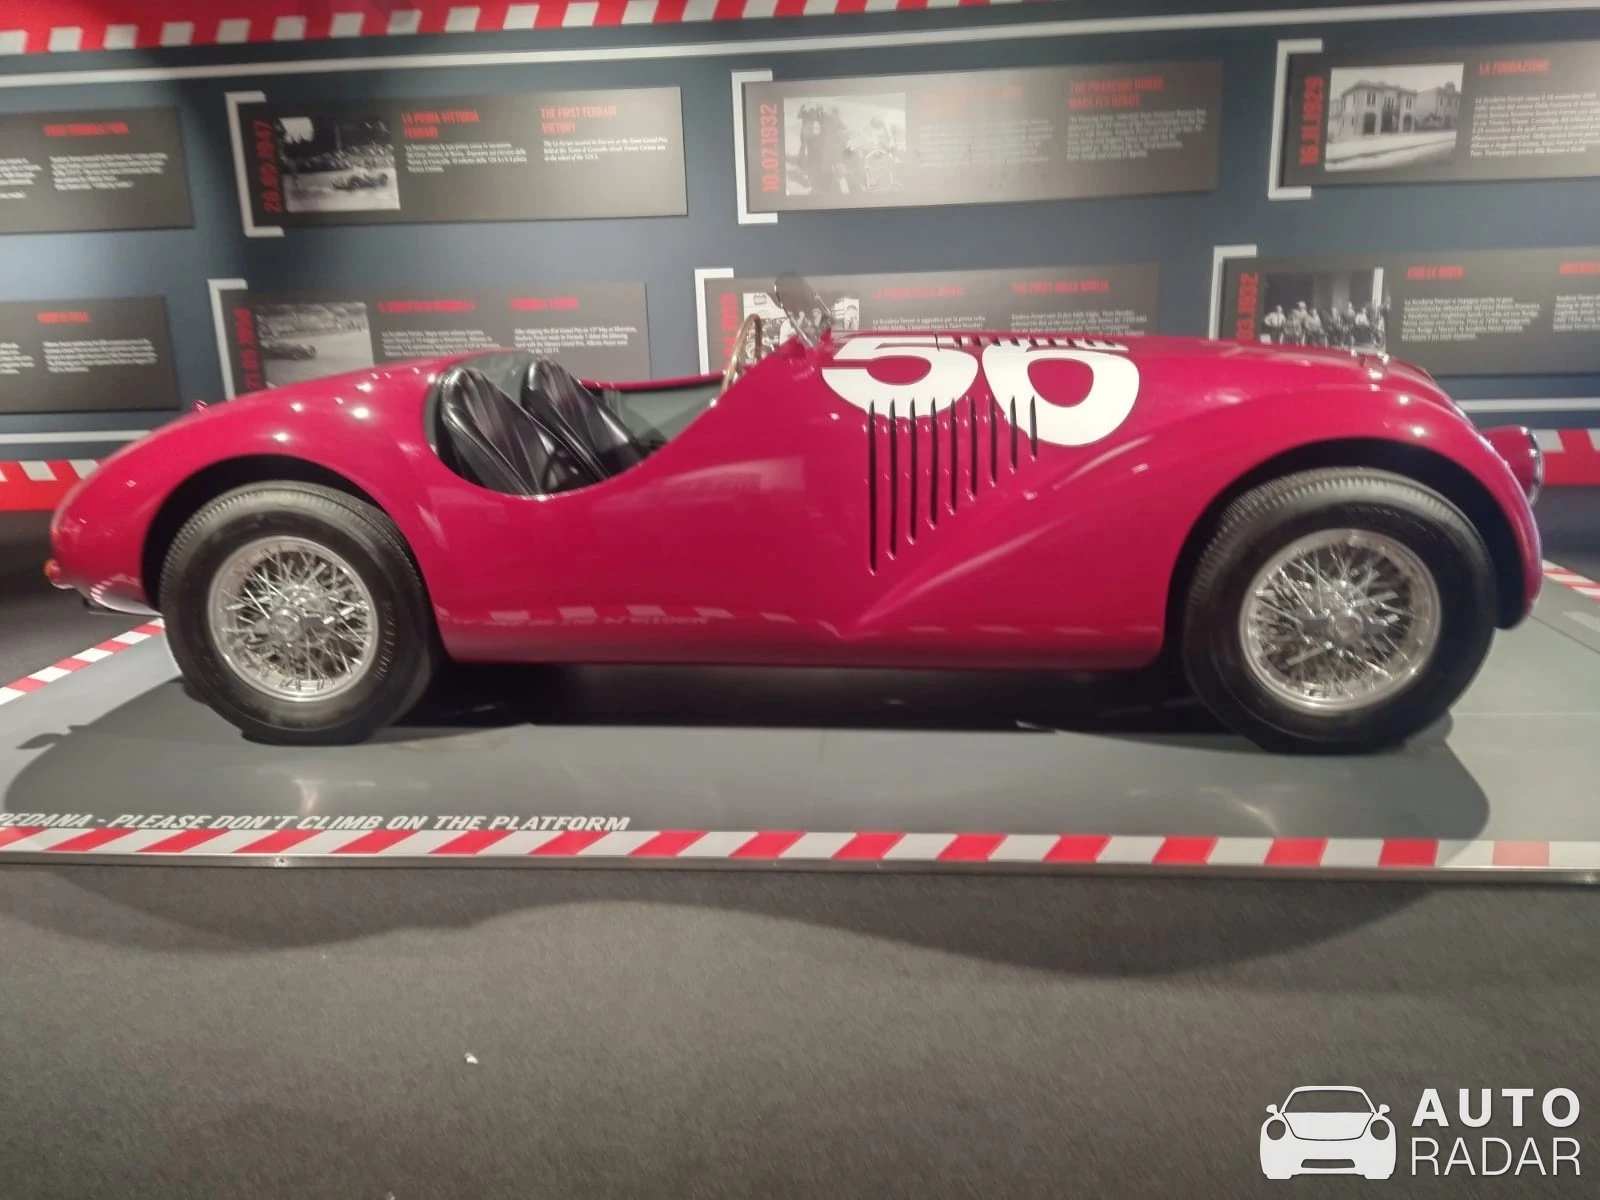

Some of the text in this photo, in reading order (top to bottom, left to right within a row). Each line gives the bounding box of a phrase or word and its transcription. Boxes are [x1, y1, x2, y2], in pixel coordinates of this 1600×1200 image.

[760, 103, 779, 193] 10.07.1932
[106, 814, 212, 829] PLEASE
[208, 815, 298, 829] DON'T
[297, 815, 383, 830] CLIMB
[386, 815, 428, 830] ON
[433, 816, 486, 830] THE
[488, 816, 630, 831] PLATFORM
